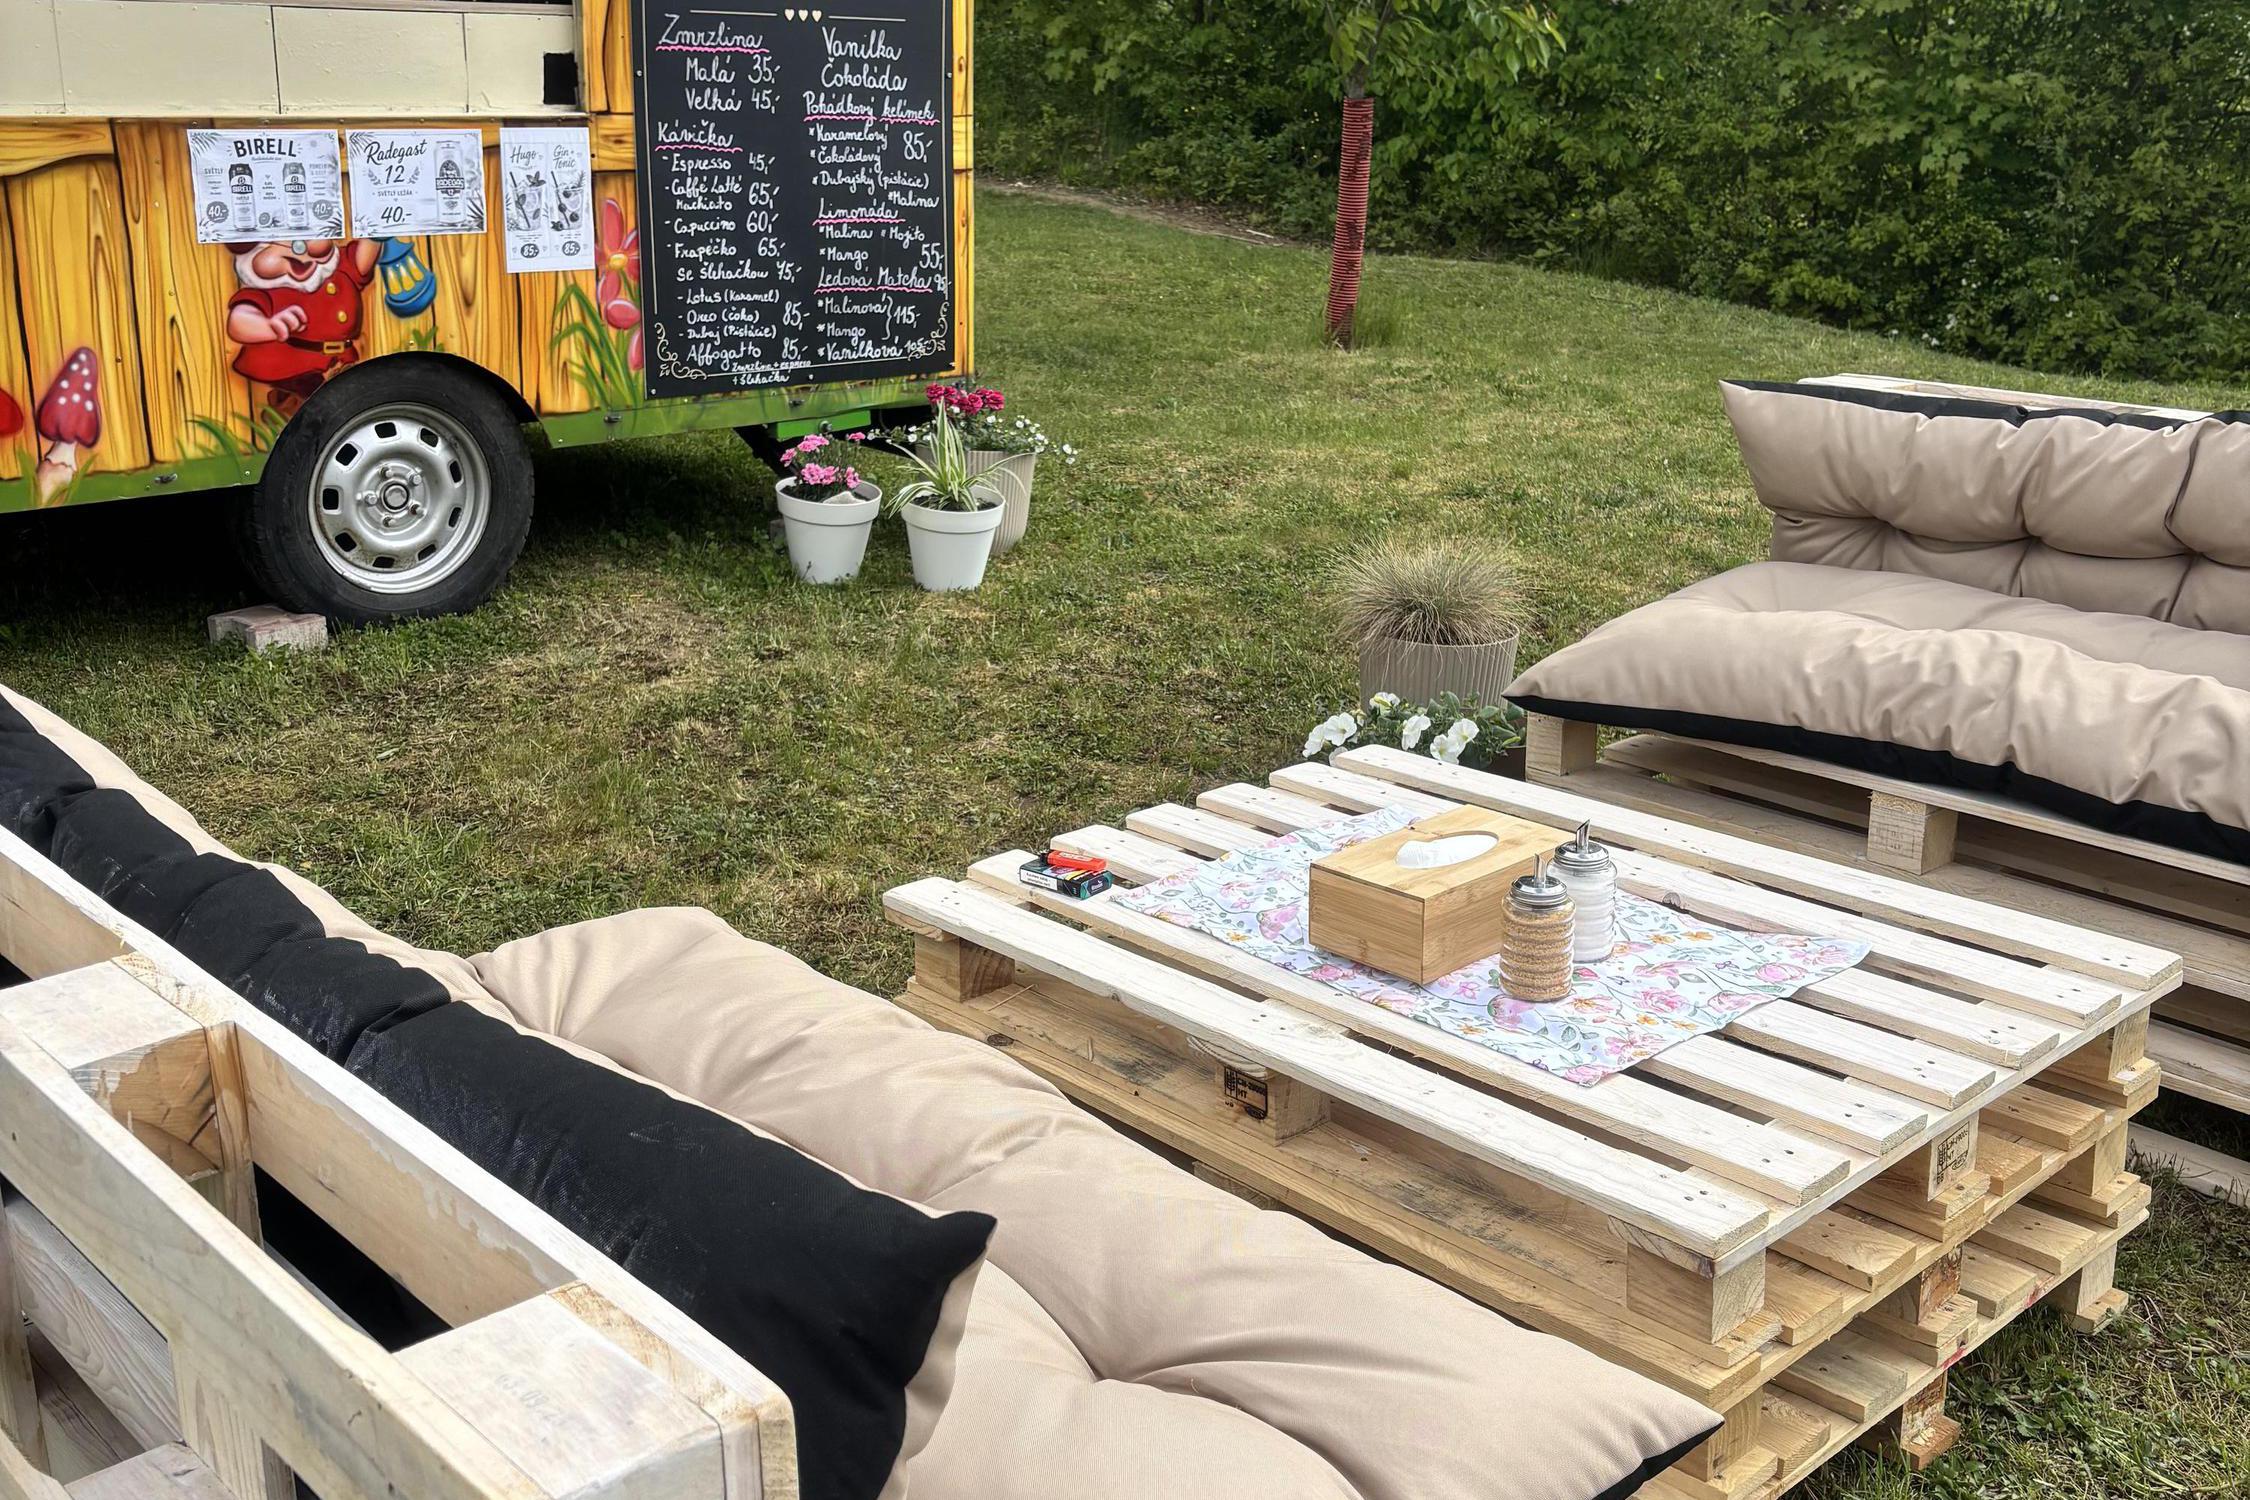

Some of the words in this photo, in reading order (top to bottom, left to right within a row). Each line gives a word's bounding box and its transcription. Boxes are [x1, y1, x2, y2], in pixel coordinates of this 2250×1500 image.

[658, 13, 763, 48] Zmrzlina
[822, 26, 902, 60] Vanilka
[685, 55, 735, 83] Malá
[821, 57, 908, 91] Čokoláda
[685, 87, 742, 111] Velká
[803, 91, 874, 125] Pohádkový
[658, 119, 734, 147] Kávička
[233, 138, 297, 158] BIRELL
[363, 139, 427, 165] Radegast
[510, 145, 537, 166] Hugo
[553, 145, 569, 157] Gin
[385, 165, 405, 184] 12
[553, 157, 576, 169] Tonic
[671, 153, 732, 176] Espresso
[820, 167, 875, 195] Dubajský
[818, 197, 898, 219] Limonáda
[674, 217, 736, 237] Capuccino
[826, 223, 873, 239] Malina
[889, 225, 925, 249] Mojito
[827, 246, 869, 270] Mango
[818, 266, 872, 287] Ledová
[877, 266, 932, 289] Matcha
[686, 287, 722, 304] Lotus
[825, 293, 888, 314] Malinová
[686, 309, 717, 324] Oreo
[687, 325, 721, 345] Dubaj
[827, 322, 866, 346] Mango
[686, 341, 761, 371] Affogatto
[826, 336, 903, 361] Vanilková
